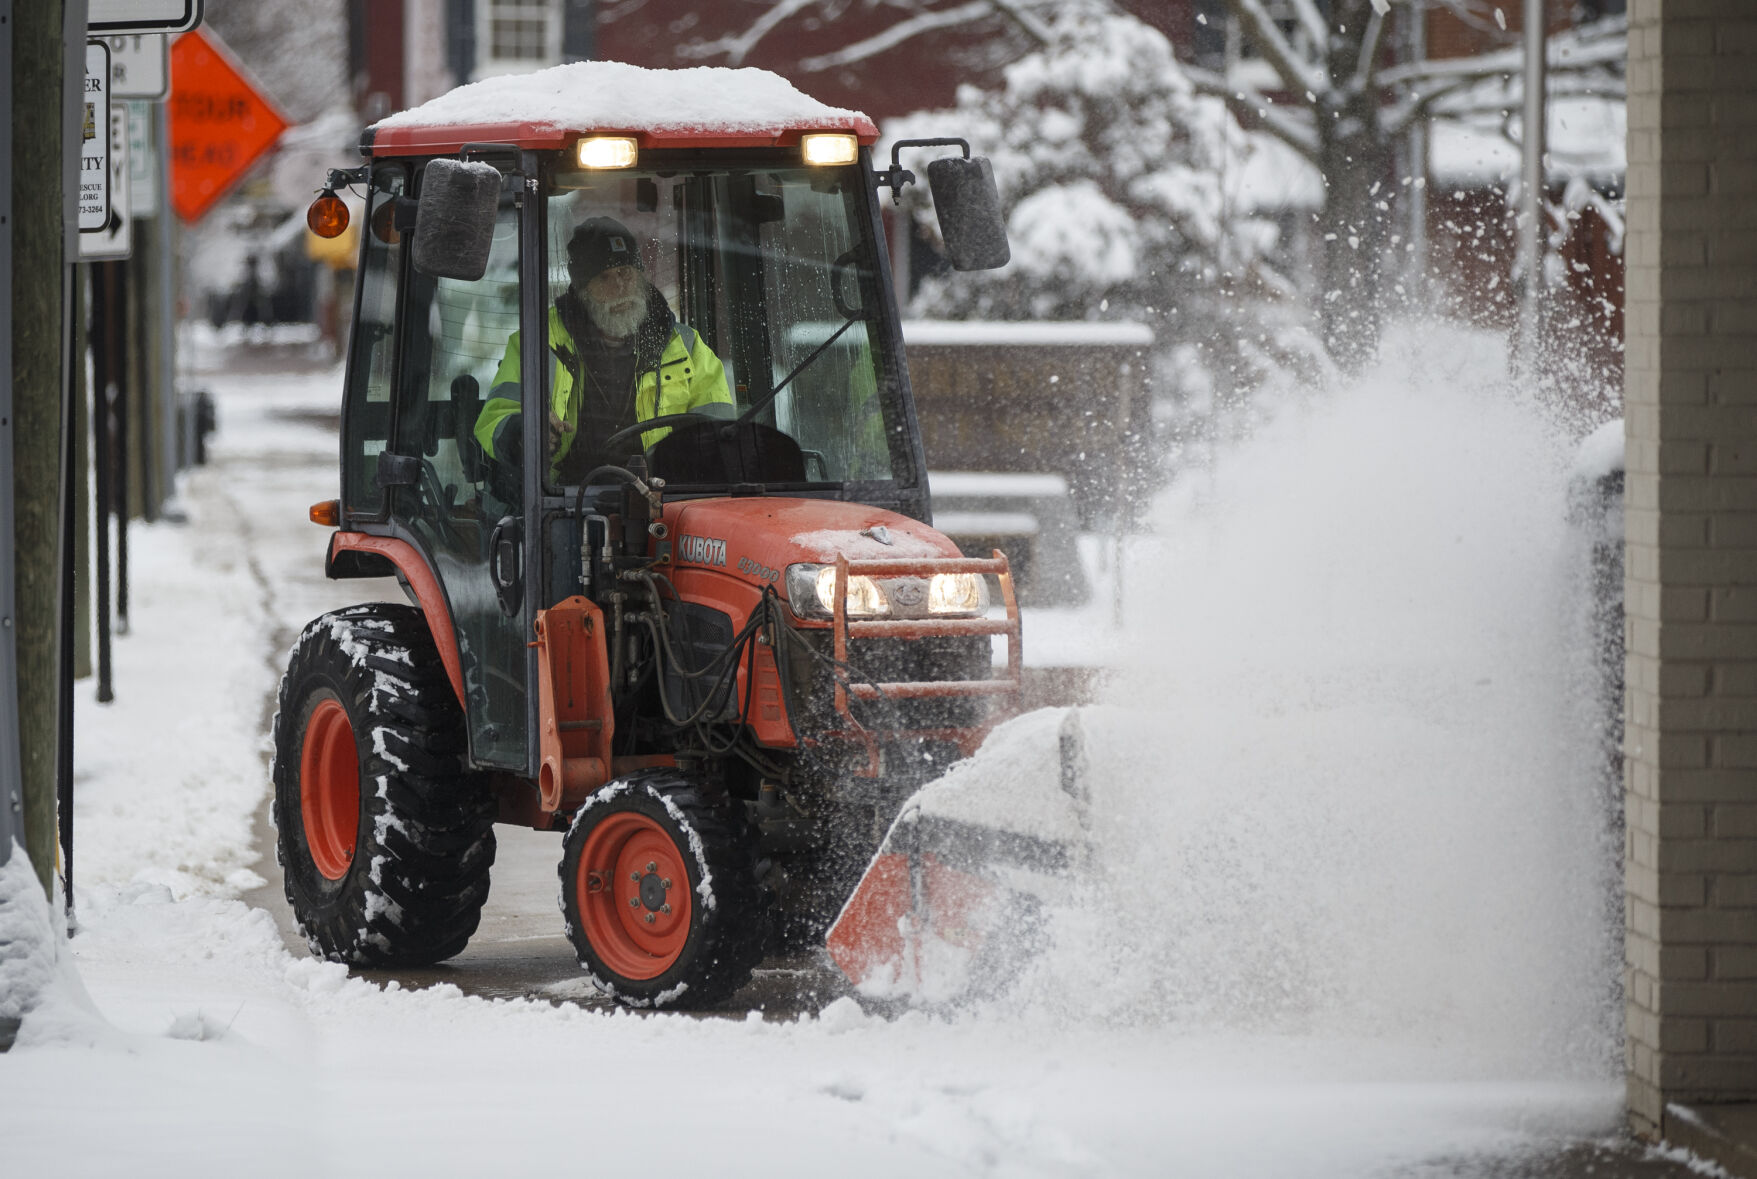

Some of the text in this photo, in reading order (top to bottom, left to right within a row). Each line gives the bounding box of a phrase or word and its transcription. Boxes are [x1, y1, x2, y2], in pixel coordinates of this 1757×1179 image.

[84, 78, 102, 92] ER
[679, 534, 727, 567] KUBOTA
[737, 556, 779, 583] B3000
